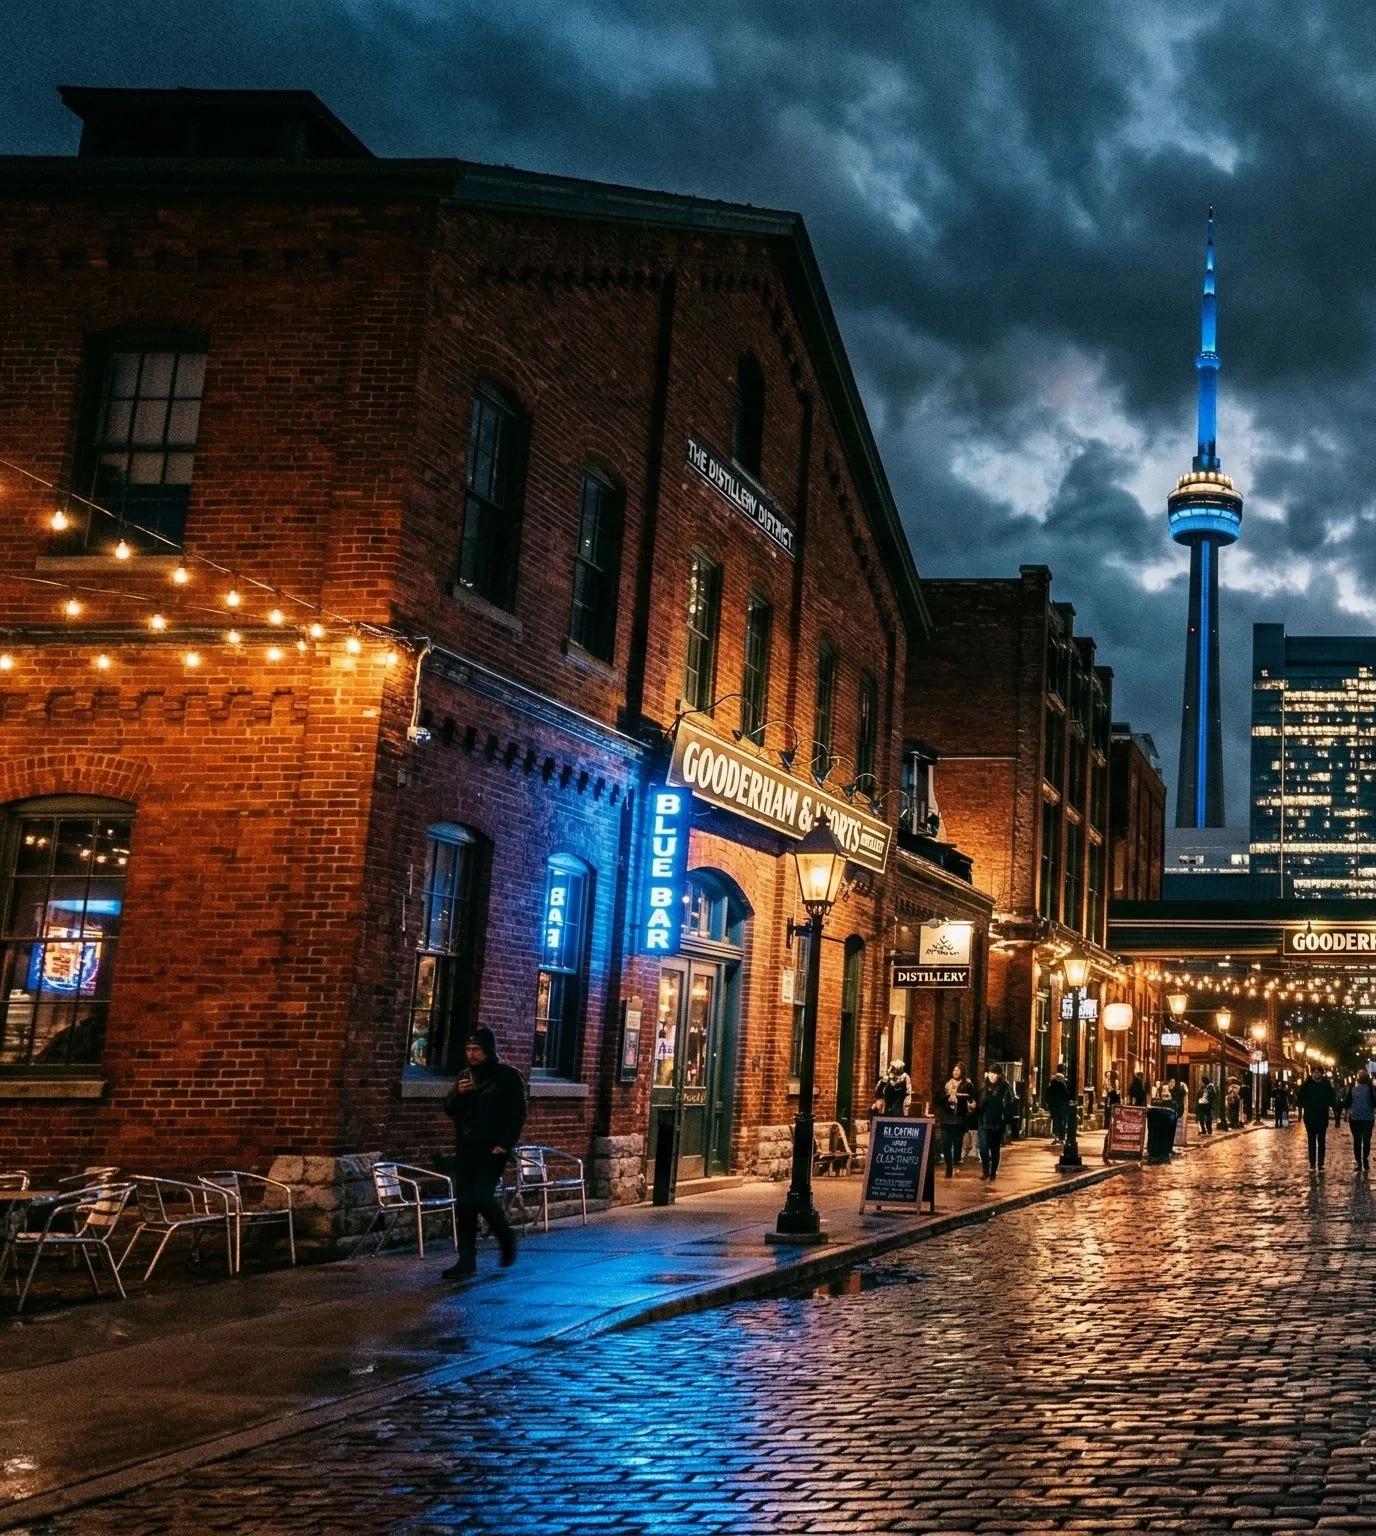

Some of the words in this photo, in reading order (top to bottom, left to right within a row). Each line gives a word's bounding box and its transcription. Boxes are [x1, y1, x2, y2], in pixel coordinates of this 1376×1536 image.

[688, 439, 707, 473] THE
[682, 741, 799, 826] GOODERHAM
[798, 794, 813, 832] &
[652, 794, 681, 878] BLUE
[645, 886, 674, 950] BAR
[897, 971, 967, 982] DISTILLERY
